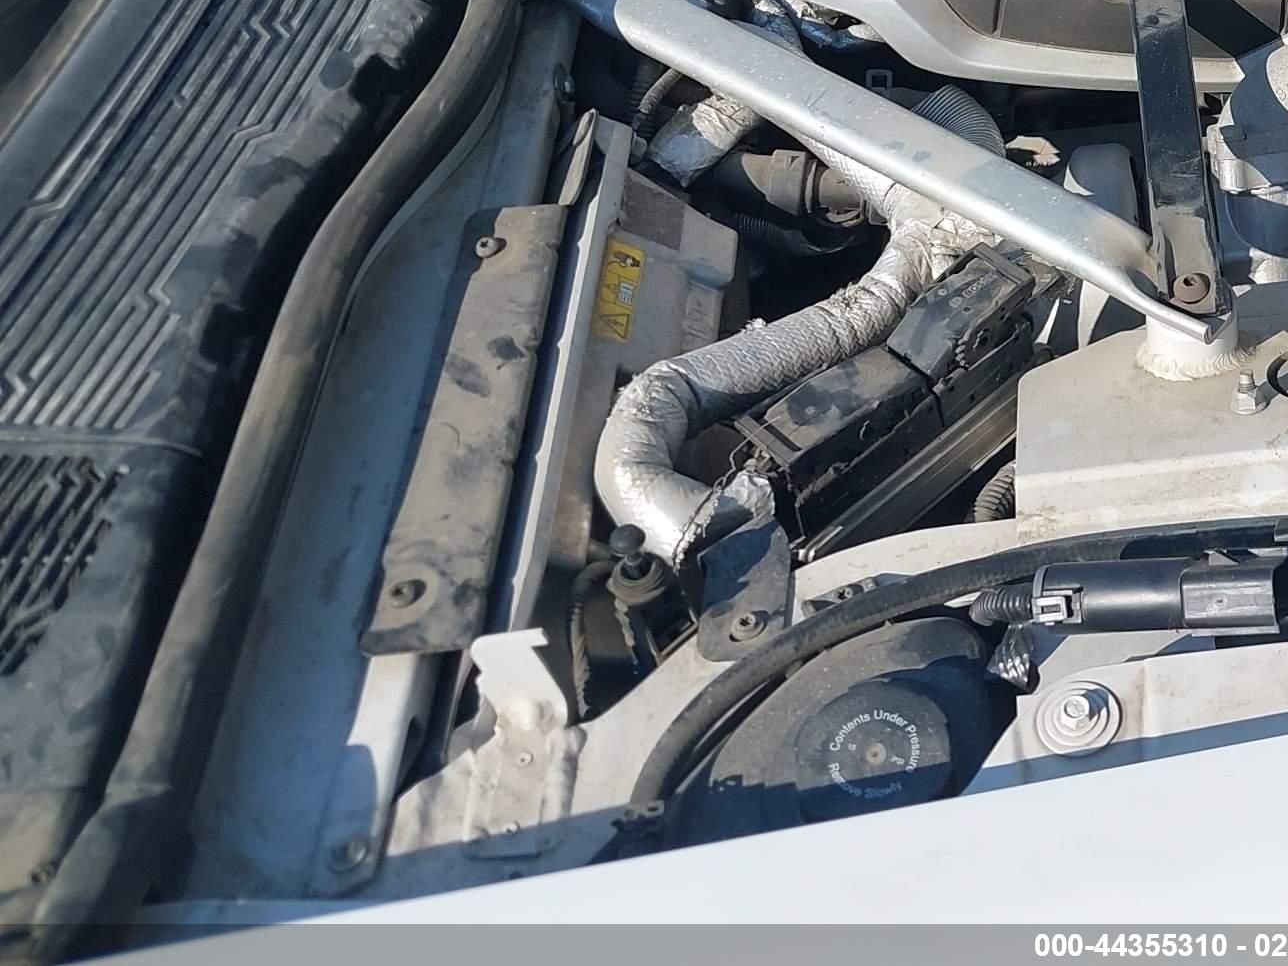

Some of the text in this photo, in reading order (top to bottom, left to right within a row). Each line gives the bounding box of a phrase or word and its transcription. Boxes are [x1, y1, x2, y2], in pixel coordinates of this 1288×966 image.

[829, 709, 921, 773] Contents Under Pressure
